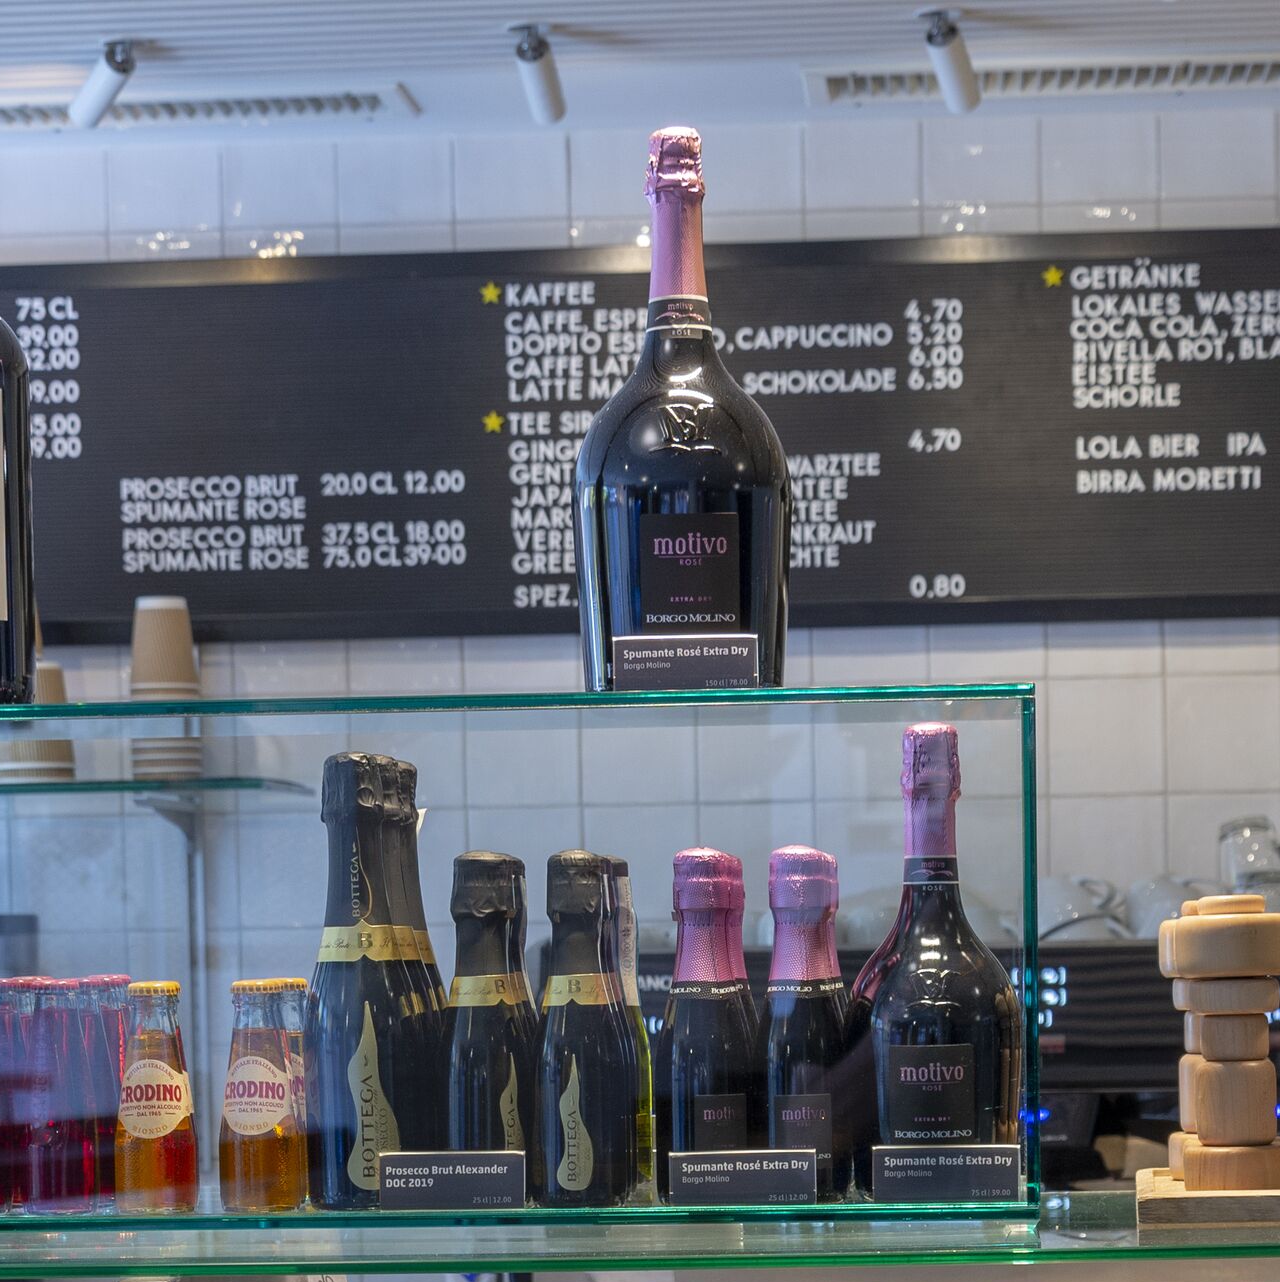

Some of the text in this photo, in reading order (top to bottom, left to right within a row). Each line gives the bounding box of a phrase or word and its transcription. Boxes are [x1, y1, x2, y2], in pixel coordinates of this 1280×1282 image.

[1070, 257, 1200, 290] GETRÄNKE
[505, 281, 595, 307] KAFFEE
[1072, 293, 1181, 319] LOKALES
[48, 296, 79, 320] CL
[903, 298, 963, 322] 4.70
[505, 323, 963, 357] DOPPIO 5.20
[1070, 317, 1143, 341] COCA
[506, 344, 963, 379] CAFFE 6.00
[1073, 338, 1172, 365] RIVELLA
[508, 368, 963, 402] LATTE 6.50
[1073, 361, 1157, 386] EISTEE
[1073, 383, 1181, 409] SCHORLE
[508, 411, 551, 436] TEE
[908, 428, 961, 453] 4.70
[1076, 432, 1266, 460] LOLA BIER IPA
[121, 470, 465, 500] PROSECCO BRUT 12.00
[1077, 466, 1261, 494] BIRRA MORETTI
[121, 499, 239, 523] SPUMANTE
[123, 519, 465, 550] PROSECCO BRUT 18.00
[653, 533, 728, 555] motivo
[123, 549, 243, 573] SPUMANTE
[910, 575, 966, 599] 0.80
[646, 614, 736, 623] BORGO MOLINO
[623, 646, 749, 660] Spumante Rosé Extra Dry
[623, 661, 671, 670] Borgo Molino
[900, 1063, 964, 1081] motivo
[121, 1084, 182, 1103] CRODINO
[225, 1080, 285, 1100] CRODINO
[361, 1075, 375, 1177] BOTTEGA
[895, 1129, 972, 1138] BORGO MOLINO
[386, 1164, 508, 1175] Prosecco Brut Alexander
[682, 1160, 809, 1173] Spumante Rosé Extra Dry
[884, 1155, 1012, 1168] Spumante Rosé Extra Dry
[884, 1169, 932, 1178] Borgo Molino
[386, 1178, 434, 1188] DOC 2019
[682, 1175, 730, 1184] Borgo Molino
